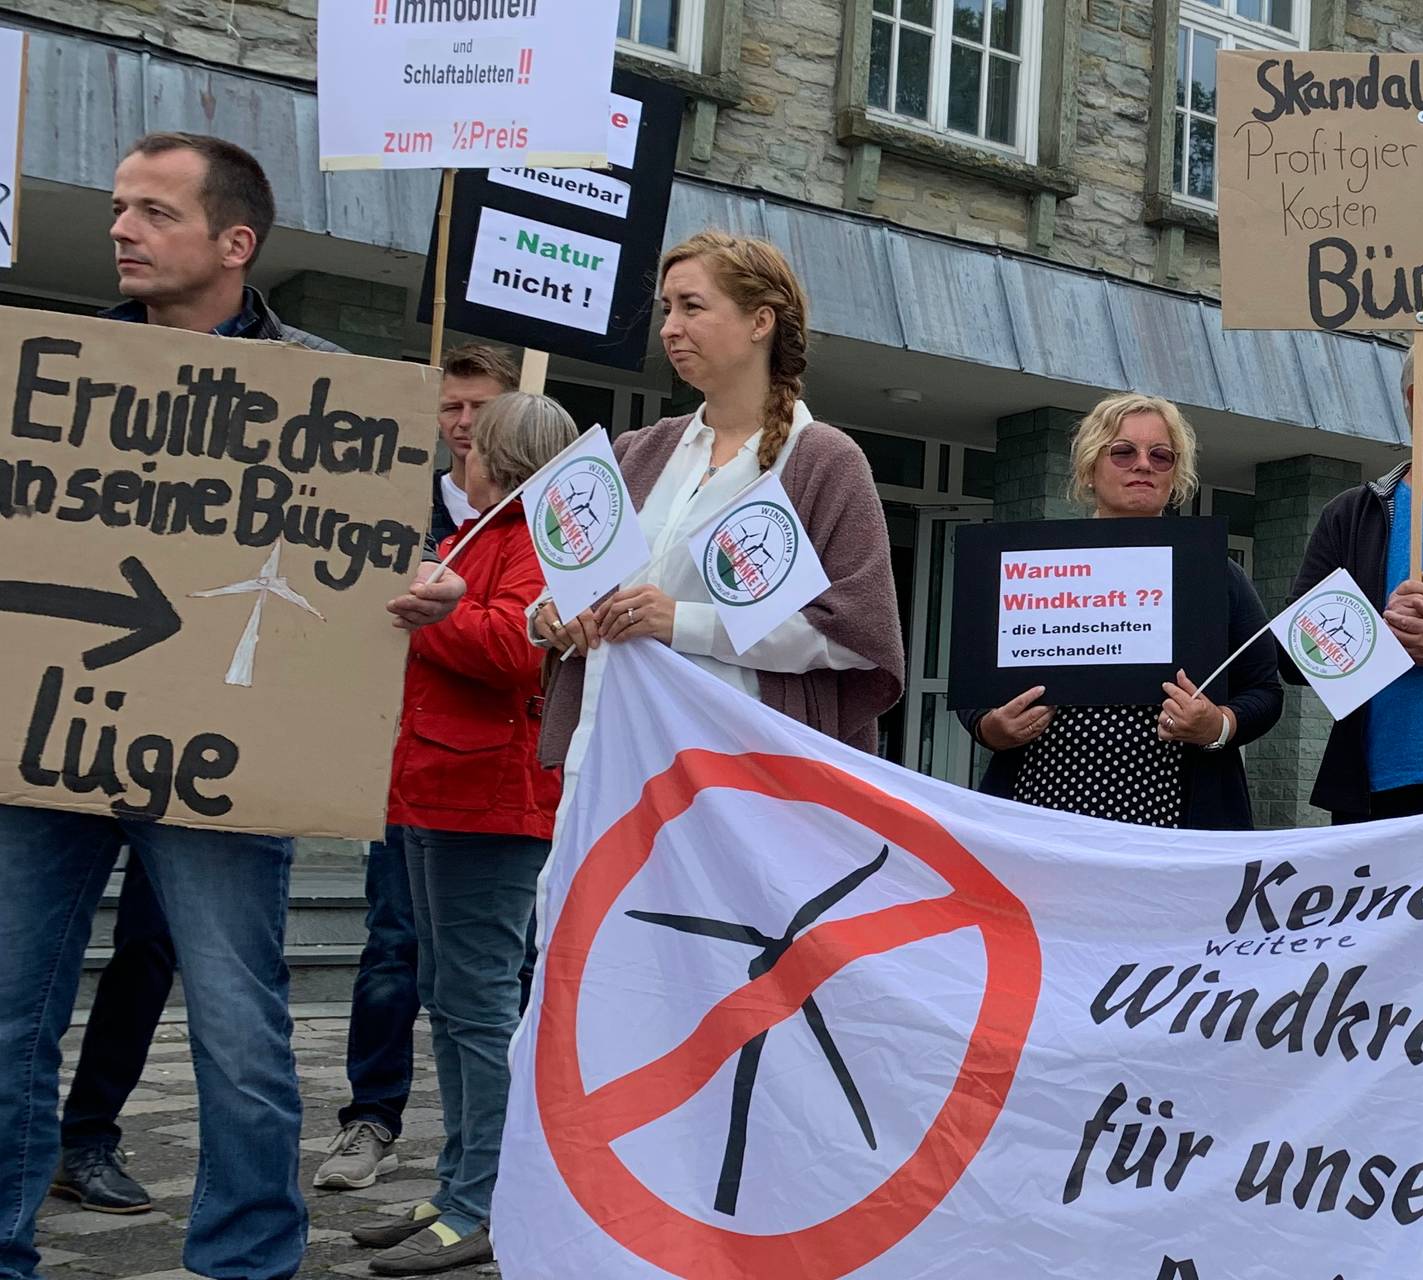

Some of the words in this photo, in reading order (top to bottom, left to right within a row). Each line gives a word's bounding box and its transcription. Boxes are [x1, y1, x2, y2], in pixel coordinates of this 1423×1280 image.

[453, 39, 474, 54] und
[384, 130, 433, 153] zum
[1233, 120, 1418, 193] Profitgier
[1280, 182, 1378, 236] Kosten
[516, 229, 605, 271] Natur
[492, 267, 573, 304] nicht
[583, 287, 593, 308] !
[588, 463, 619, 518] WINDWAHN
[56, 462, 232, 536] seine
[234, 464, 421, 590] Bürger
[548, 485, 569, 516] NEIN
[560, 510, 585, 551] DANKE
[761, 506, 793, 554] WINDWAHN
[732, 552, 760, 588] DANKE
[1004, 561, 1092, 580] Warum
[1003, 590, 1127, 611] Windkraft
[1135, 589, 1164, 606] ??
[1012, 624, 1036, 636] die
[1042, 620, 1152, 635] Landschaften
[1298, 615, 1323, 639] NEIN
[1317, 633, 1345, 664] DANKE
[1011, 643, 1123, 658] verschandelt!
[1205, 931, 1357, 957] weitere
[1062, 1081, 1215, 1206] für
